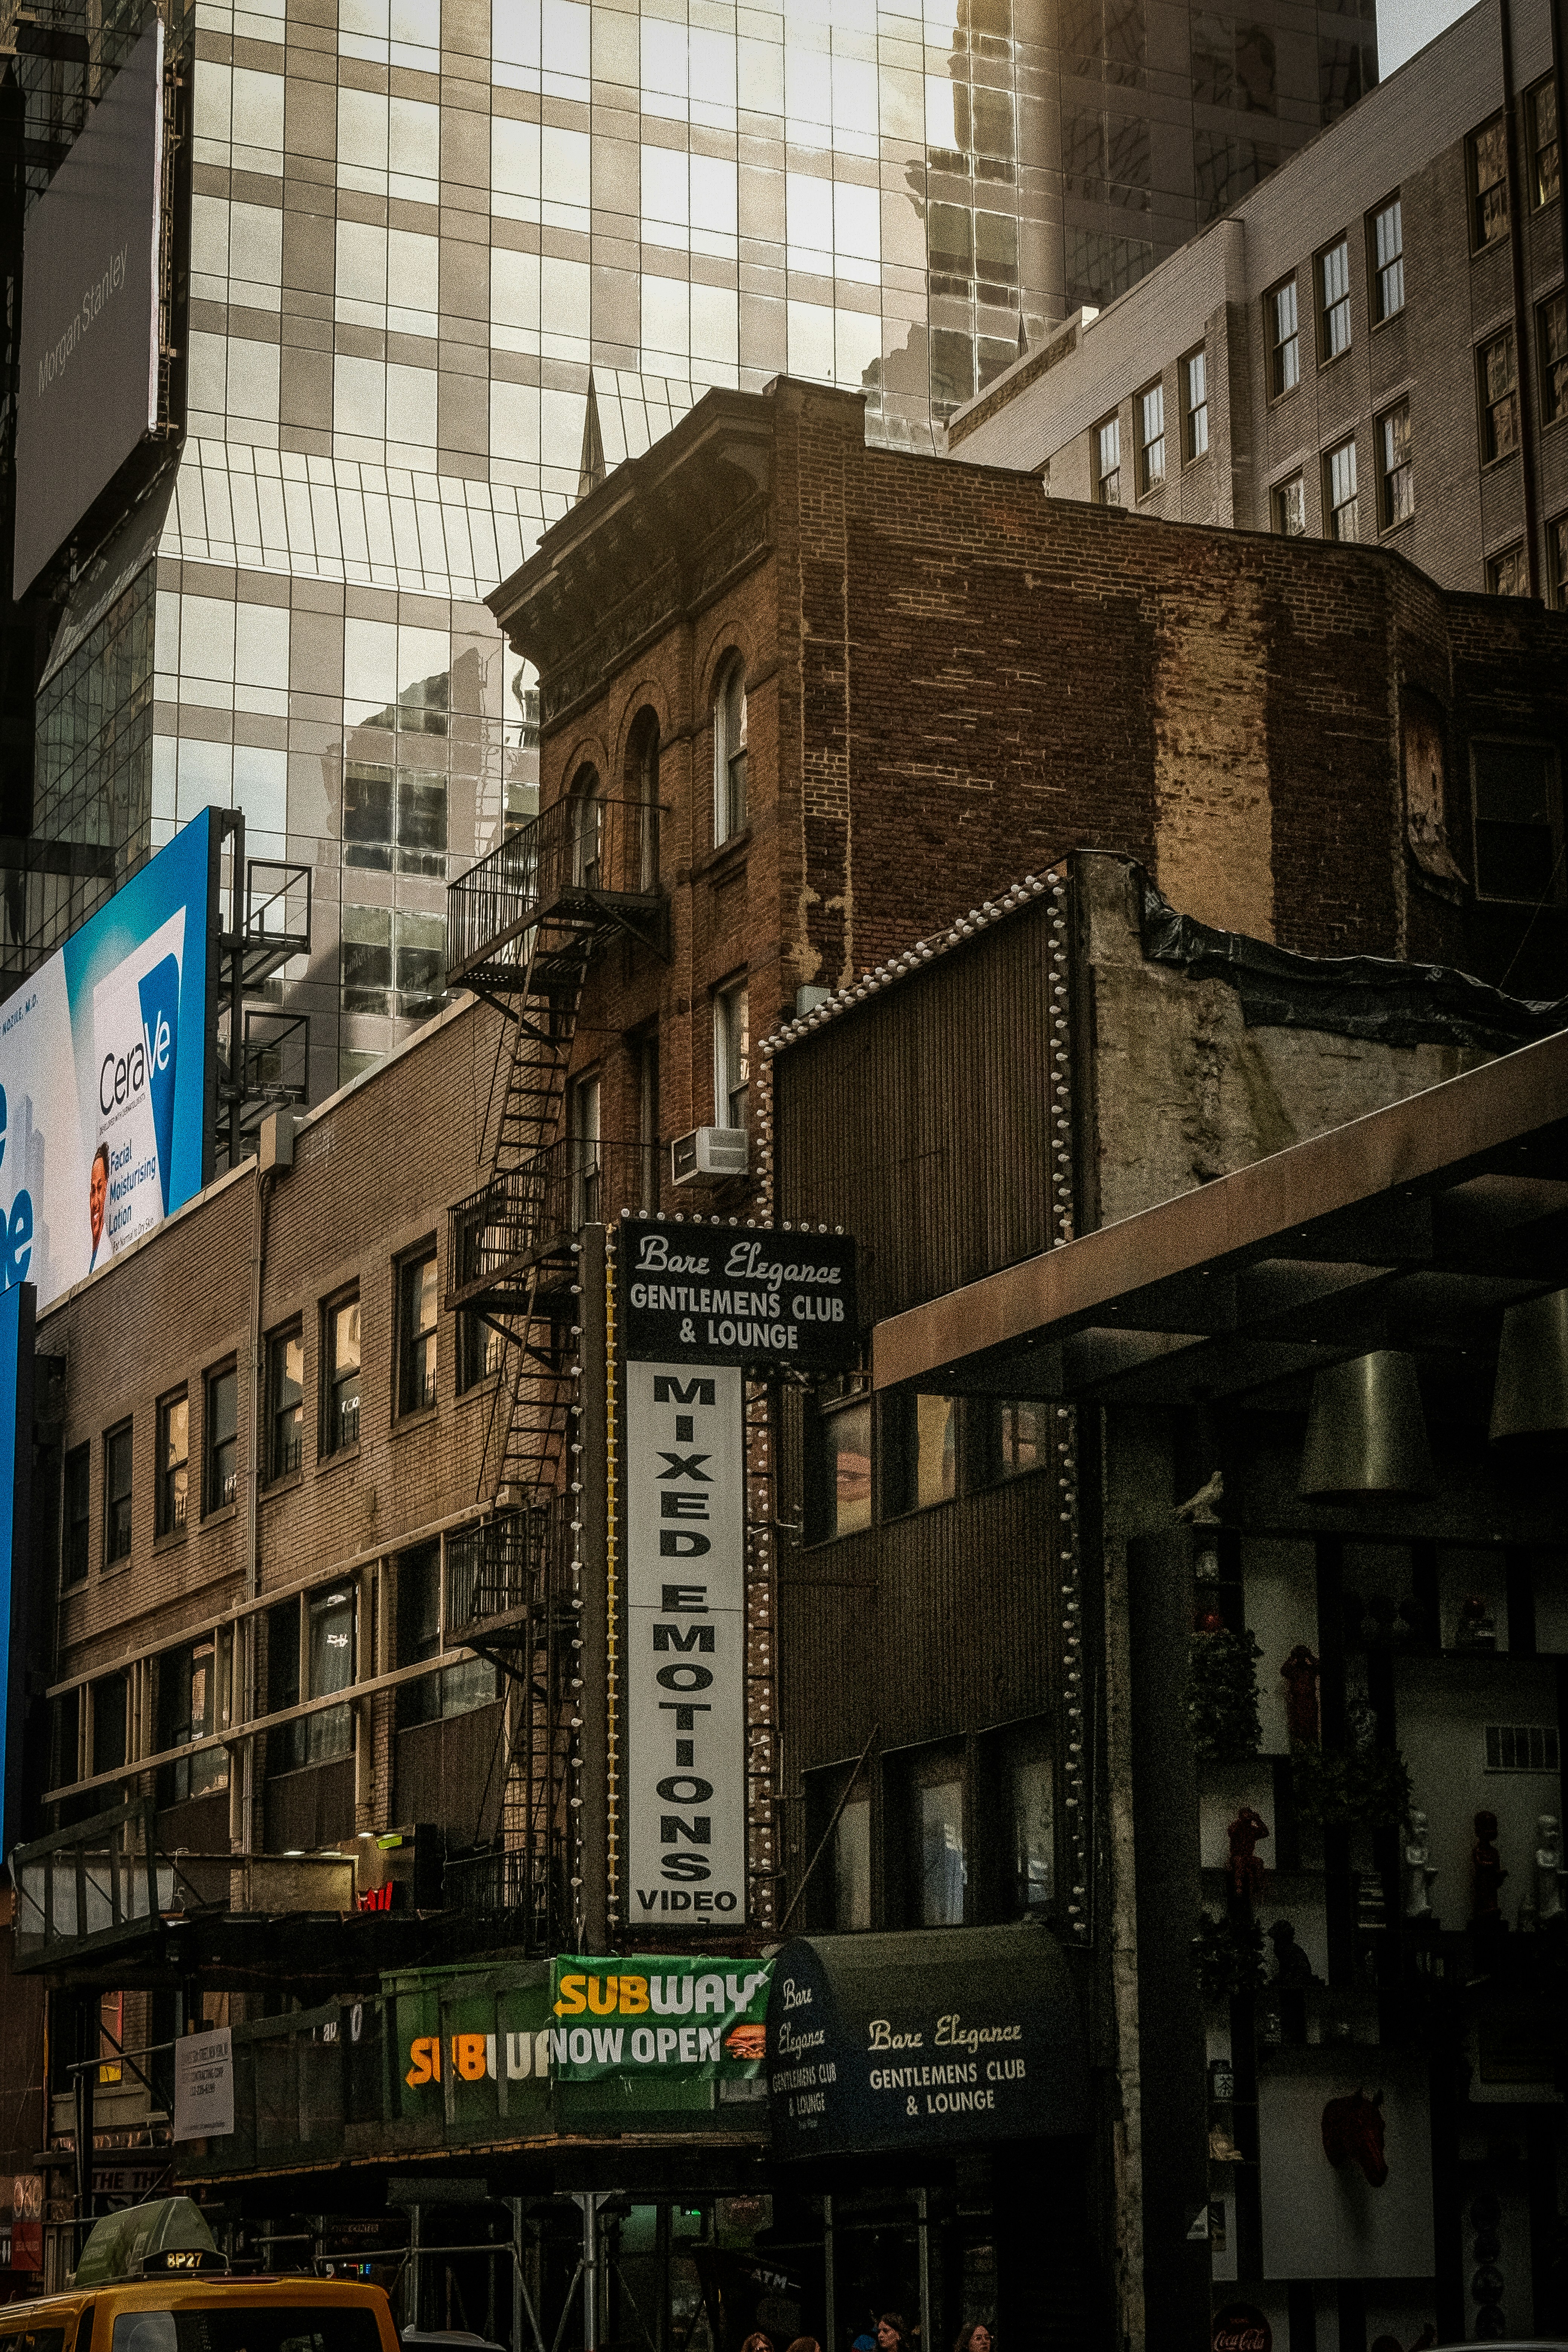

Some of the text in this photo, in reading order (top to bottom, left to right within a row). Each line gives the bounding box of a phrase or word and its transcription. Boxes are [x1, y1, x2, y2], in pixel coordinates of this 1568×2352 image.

[38, 243, 127, 397] Morgan Stanley
[100, 1010, 170, 1115] CeraVe
[110, 1139, 132, 1175] Facial
[109, 1155, 156, 1202] Moisturising
[109, 1204, 132, 1236] Lotion
[635, 1236, 842, 1291] Bare Elegance
[631, 1283, 844, 1321] GENTLEMENS CLUB
[679, 1318, 798, 1350] & LOUNGE
[652, 1375, 716, 1882] MIXED EMOTIONS
[636, 1890, 737, 1911] VIDEO
[553, 1970, 770, 2017] SUBWAY
[783, 1978, 813, 2011] Bare
[550, 2027, 720, 2063] NOW OPEN
[778, 2021, 825, 2061] Elegance
[868, 2014, 1021, 2053] Bare Elegance
[772, 2061, 837, 2093] GENTLEMENS CLUB
[870, 2058, 1026, 2090] GENTLEMENS CLUB
[796, 2092, 825, 2115] LOUNGE
[907, 2090, 995, 2115] & LOUNGE
[92, 2172, 124, 2189] THE
[167, 2251, 204, 2269] 8P27
[750, 2268, 787, 2289] ATM
